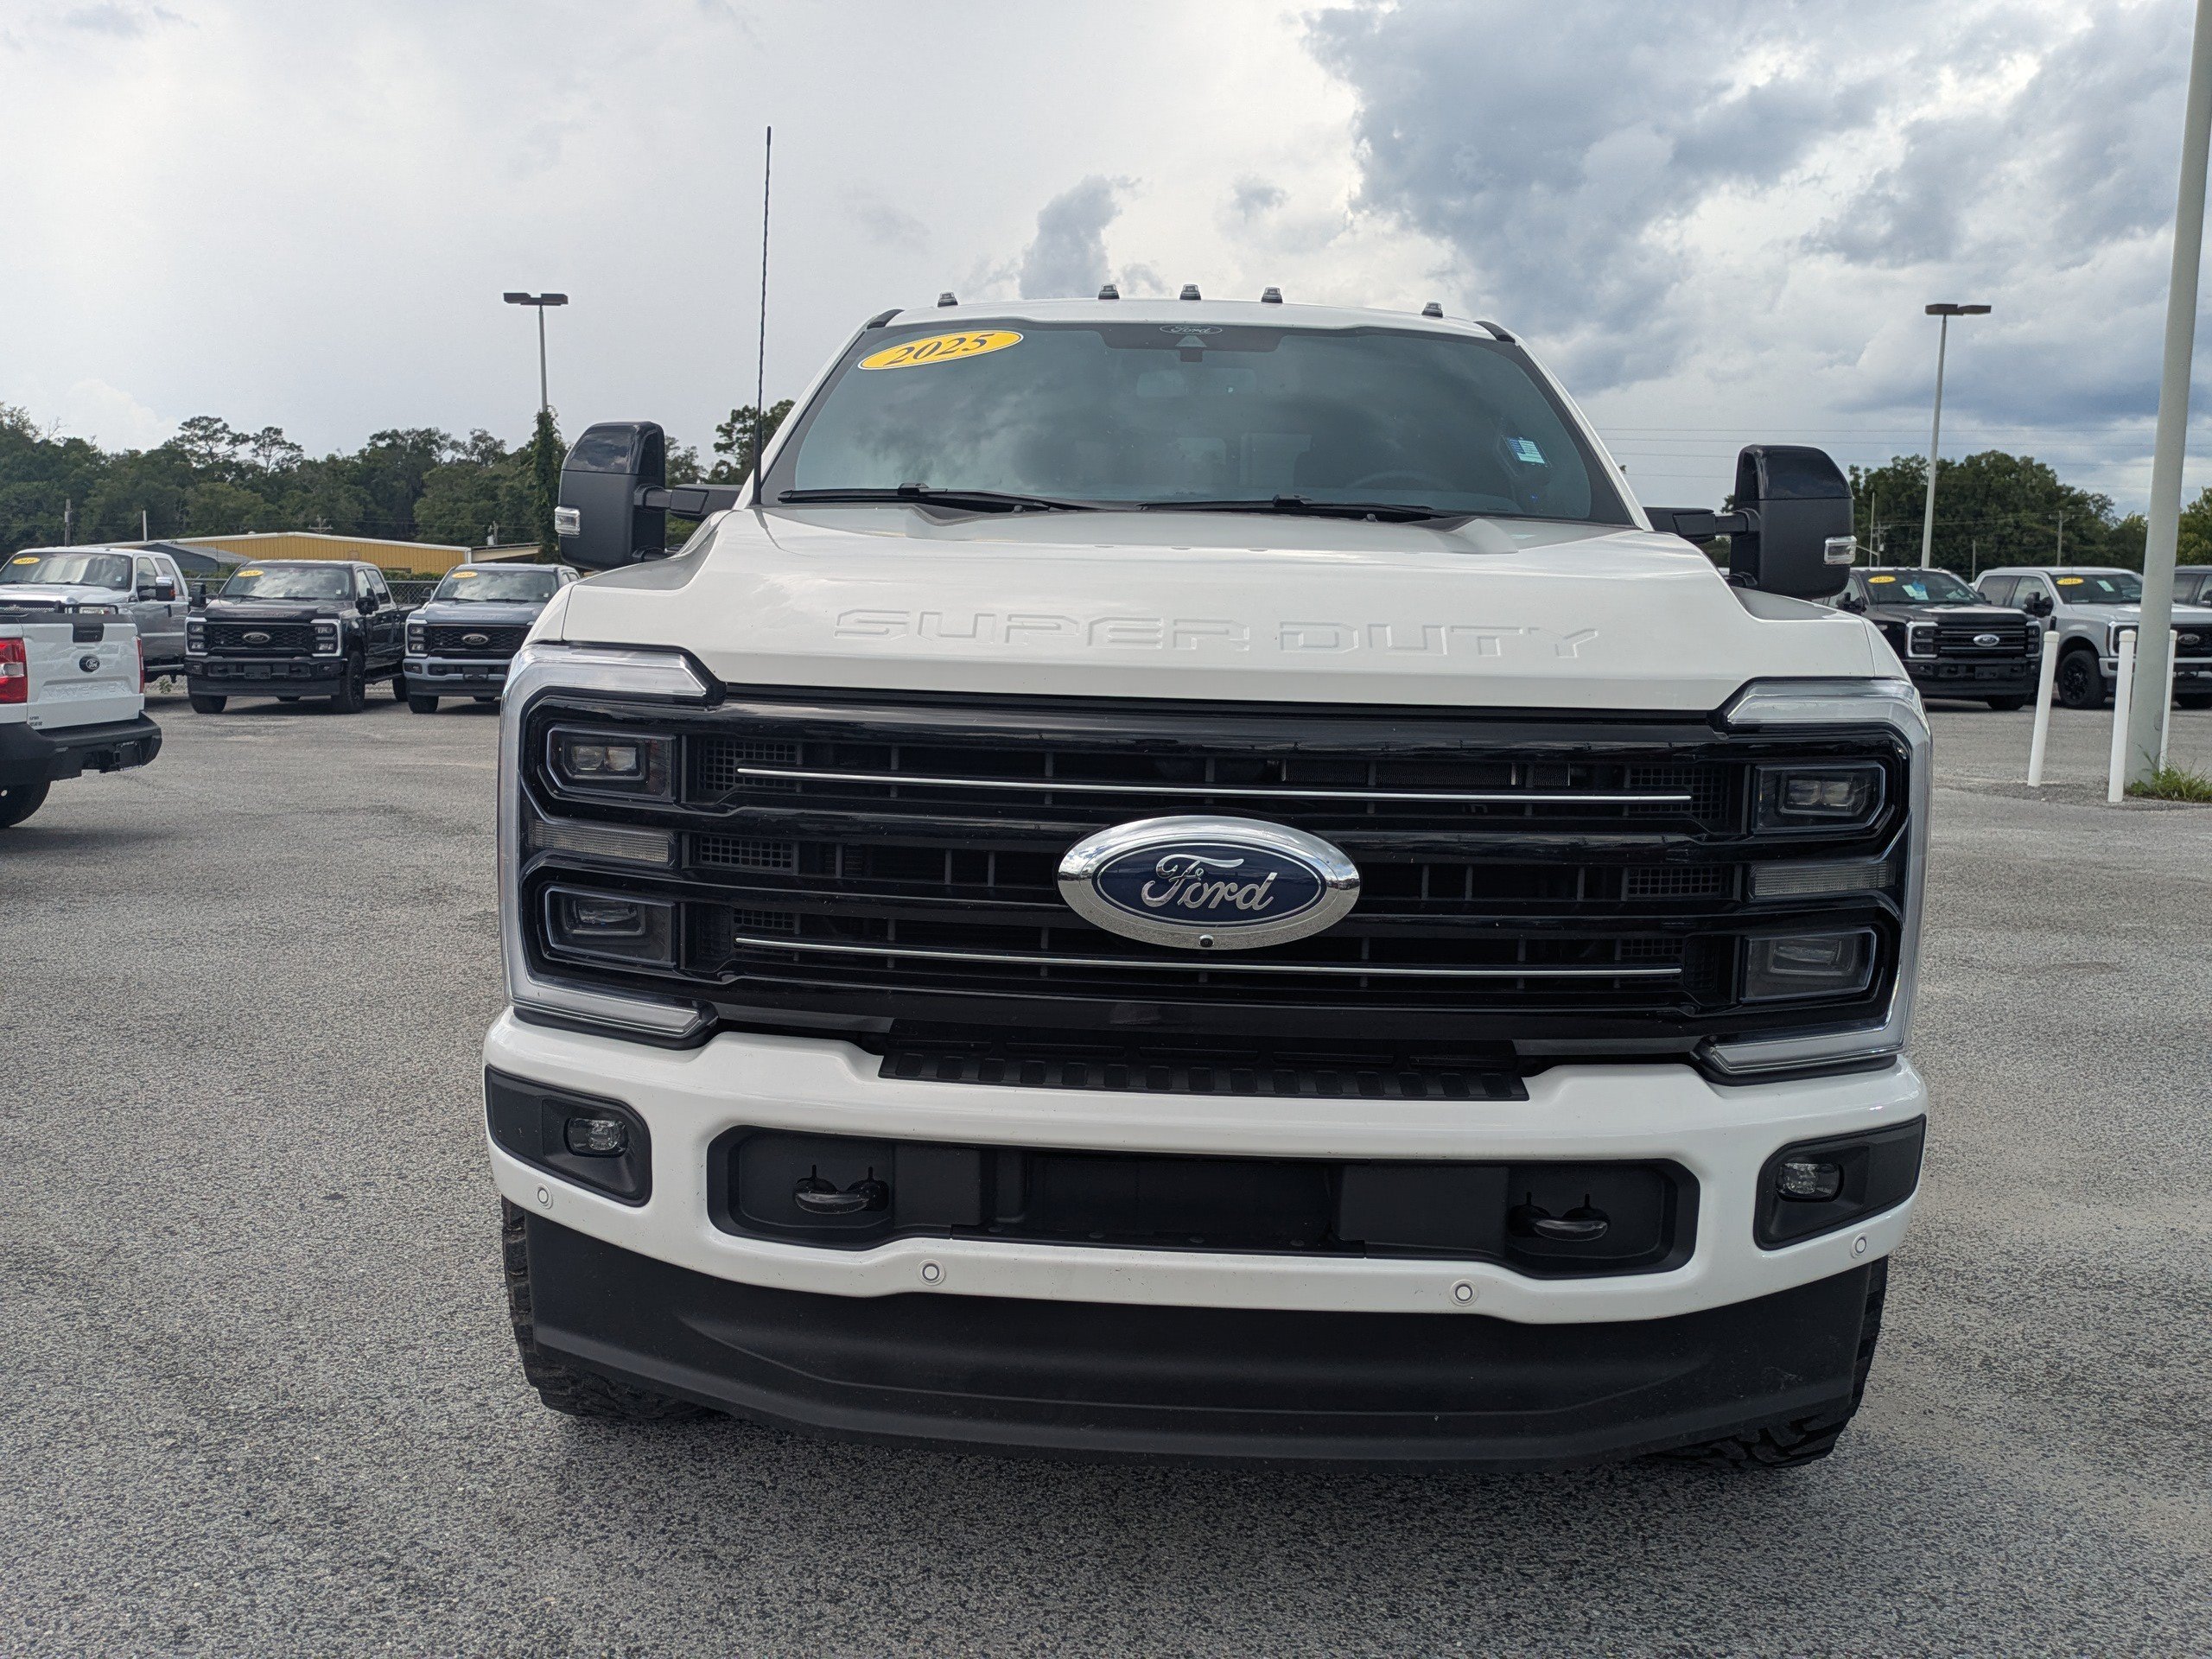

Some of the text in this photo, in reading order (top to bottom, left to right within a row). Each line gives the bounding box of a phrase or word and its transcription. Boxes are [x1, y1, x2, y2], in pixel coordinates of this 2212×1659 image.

[882, 333, 995, 366] 2025
[1171, 325, 1211, 334] Ford
[833, 608, 1599, 658] SUPER DUTY
[1141, 854, 1278, 911] Ford
